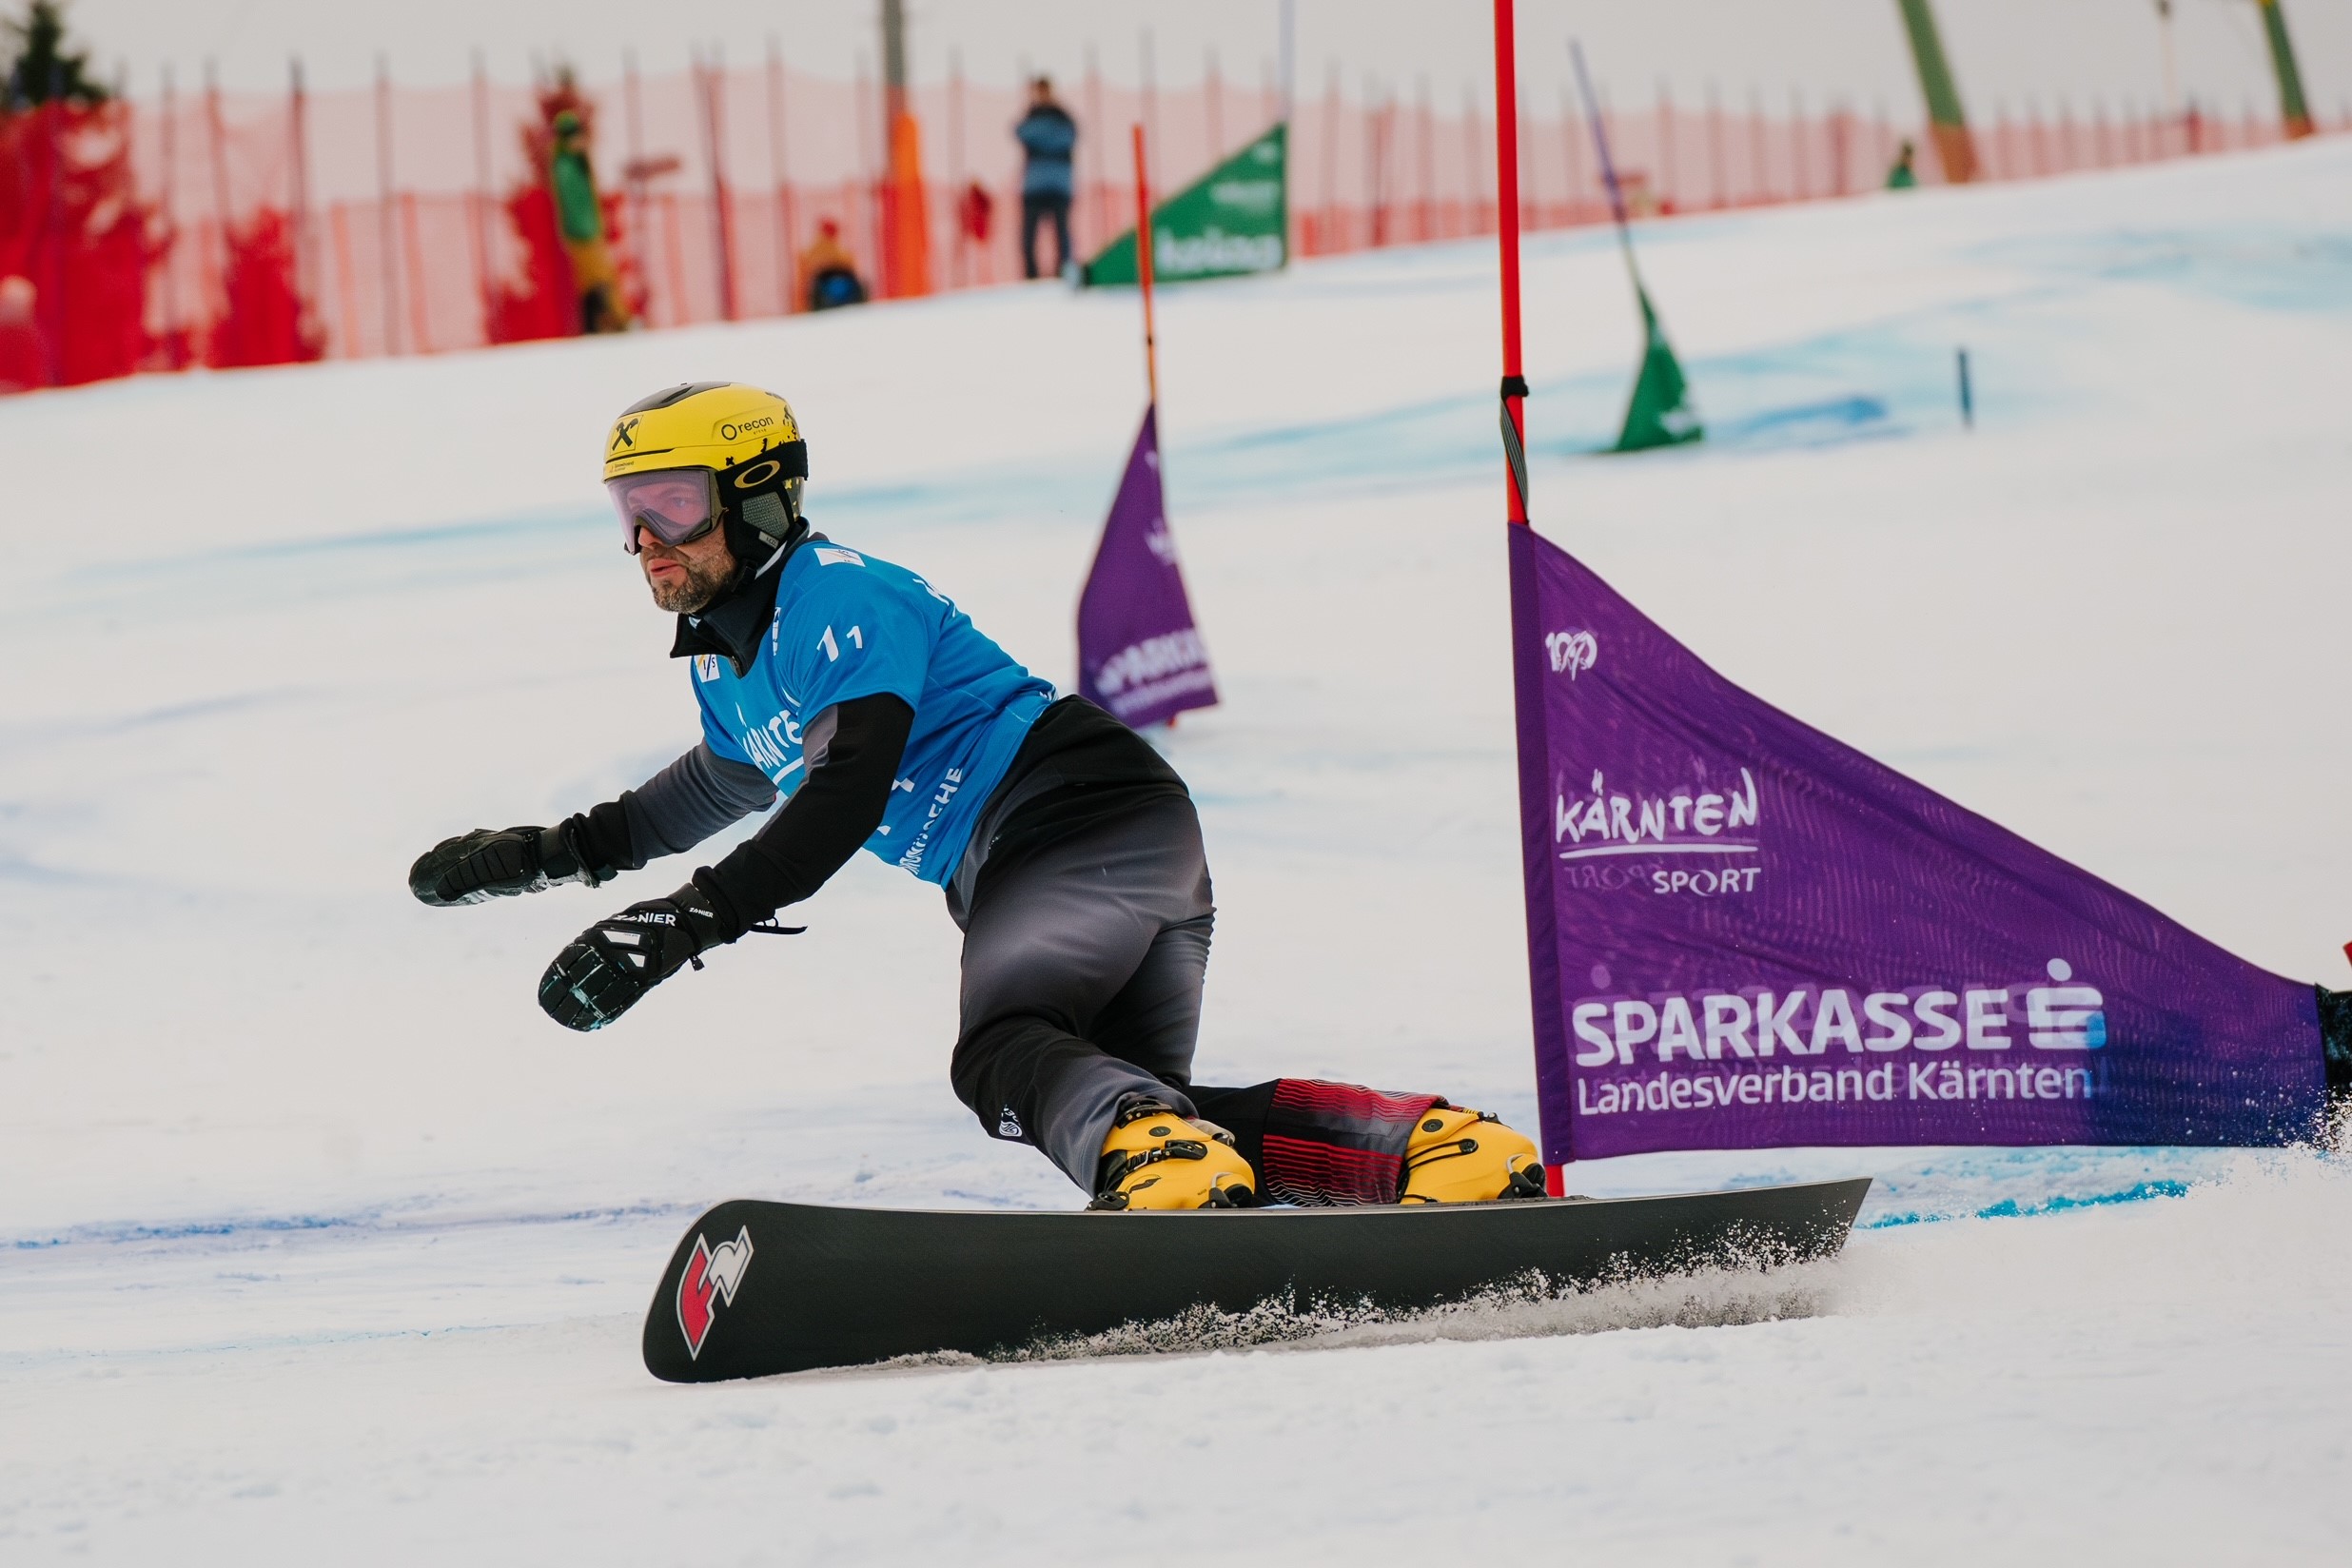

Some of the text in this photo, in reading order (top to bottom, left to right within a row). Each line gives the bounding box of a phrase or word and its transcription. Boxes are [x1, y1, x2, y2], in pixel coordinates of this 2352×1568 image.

[1556, 767, 1757, 843] KÄRNTEN
[1653, 866, 1761, 897] SPORT
[689, 907, 714, 918] ZANIER
[1573, 989, 2011, 1067] SPARKASSE
[1578, 1061, 2091, 1115] Landesverband Kärnten
